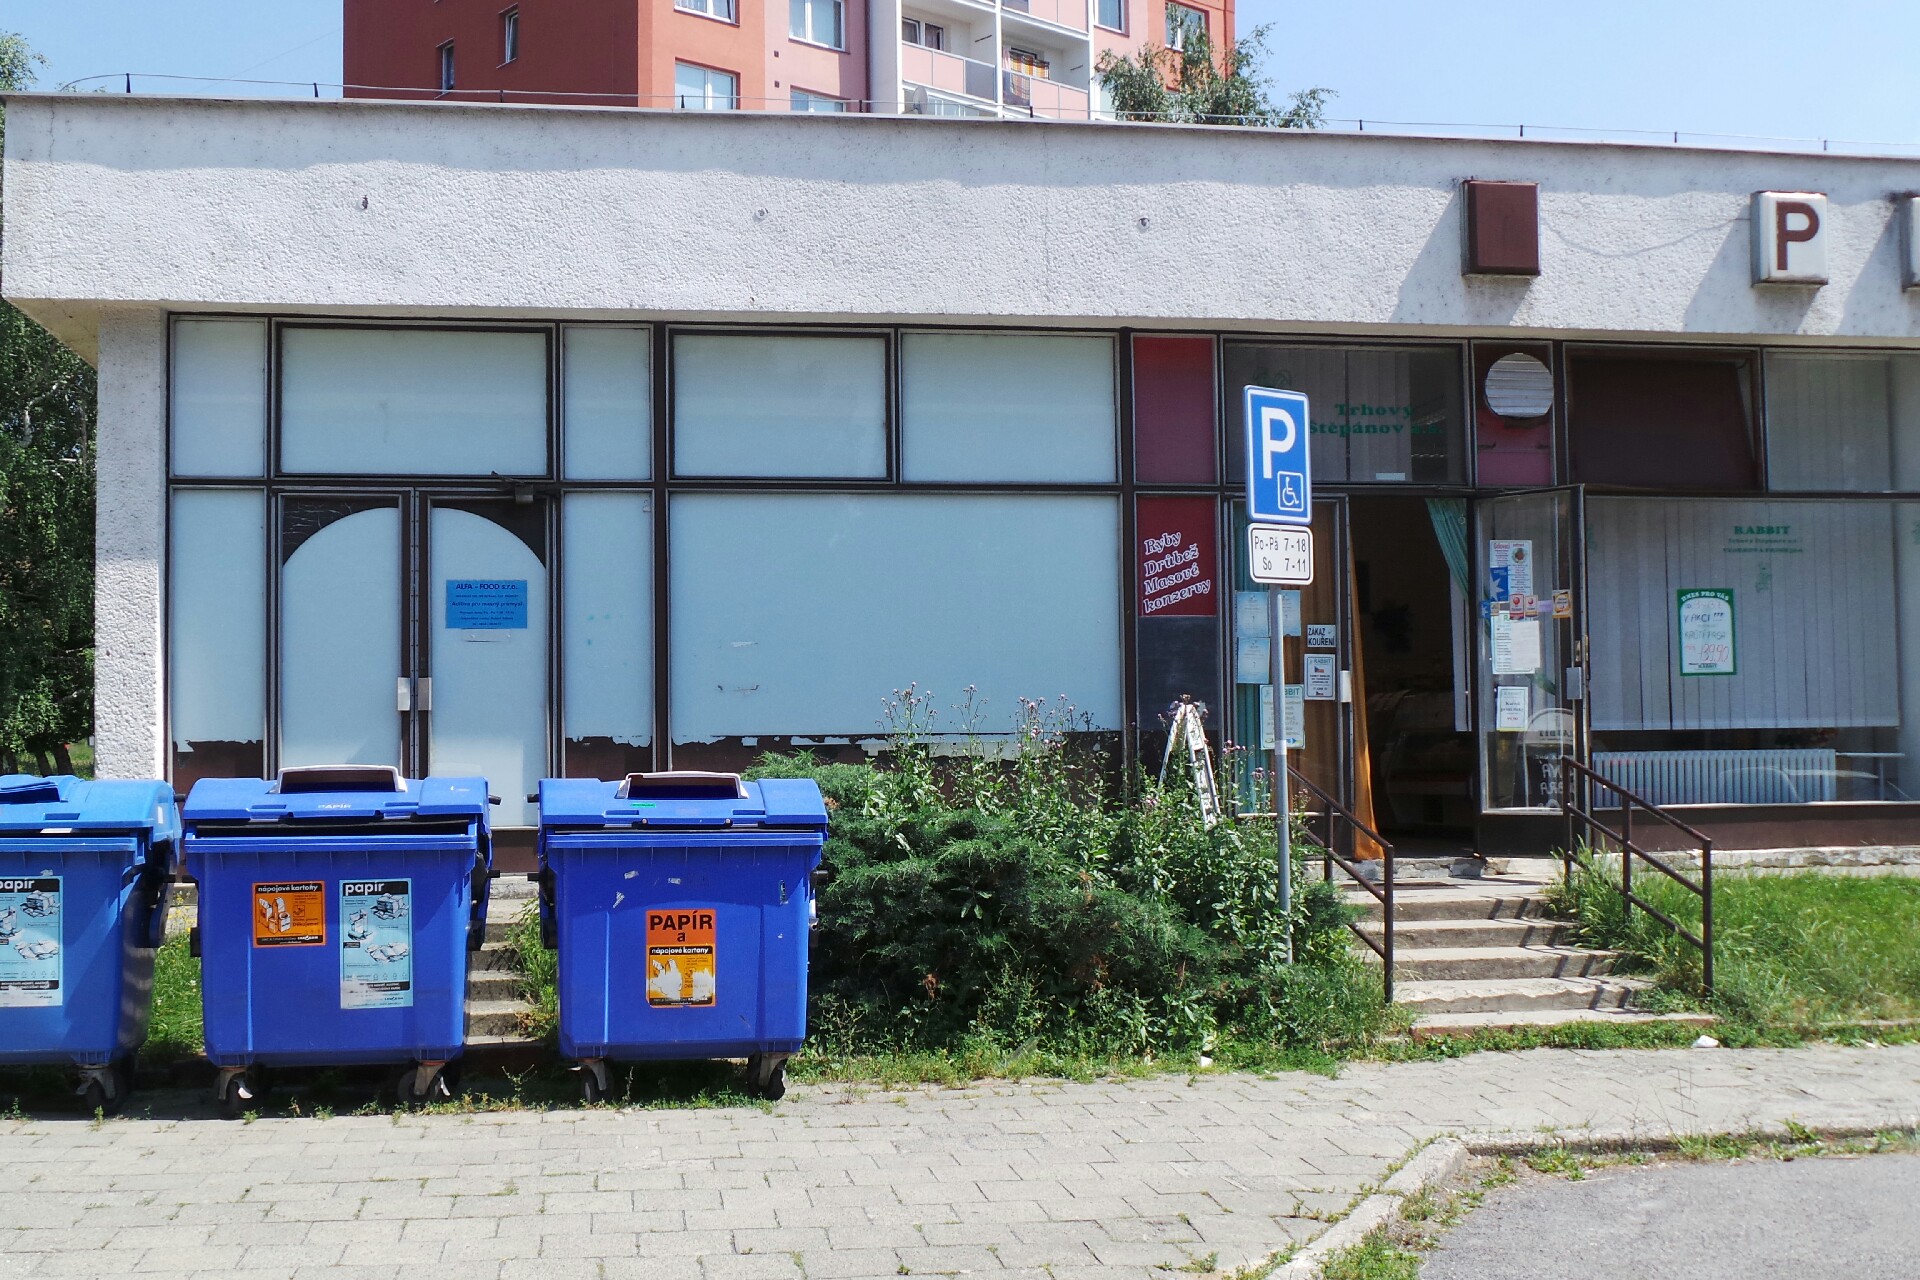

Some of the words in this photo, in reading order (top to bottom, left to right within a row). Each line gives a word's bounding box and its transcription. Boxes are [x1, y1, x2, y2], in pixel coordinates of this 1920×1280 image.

[1776, 201, 1820, 270] P
[1335, 403, 1414, 418] Trhový
[1260, 406, 1296, 479] P
[1734, 525, 1791, 535] RABBIT
[1144, 532, 1181, 555] Ryby
[1144, 543, 1199, 577] Drůbež
[1262, 556, 1273, 571] So
[1144, 562, 1200, 595] Masové
[1143, 579, 1211, 613] konzervy
[345, 881, 385, 896] papír
[650, 910, 713, 931] PAPÍR
[677, 932, 686, 942] a
